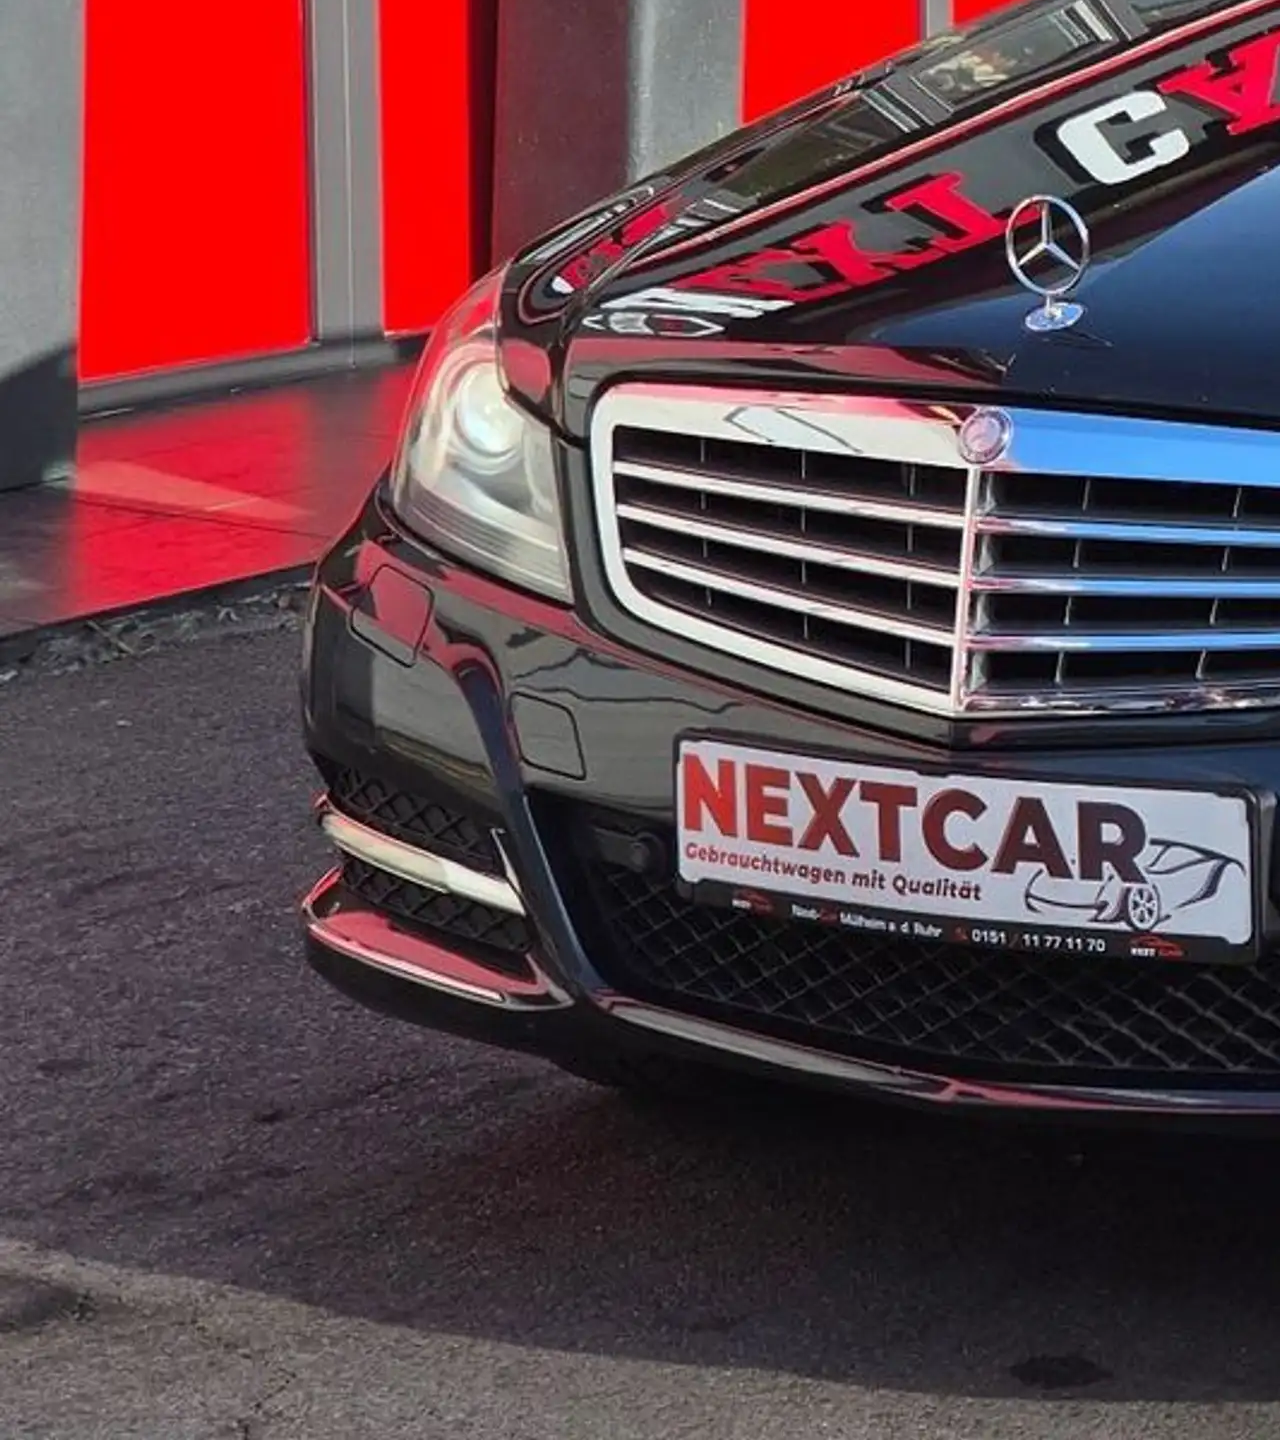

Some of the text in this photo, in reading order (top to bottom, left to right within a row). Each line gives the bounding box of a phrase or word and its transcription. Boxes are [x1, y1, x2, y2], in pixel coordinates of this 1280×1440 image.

[682, 754, 1149, 884] NEXTCAR
[684, 842, 983, 901] Gebrauchtwagen mit Qualität
